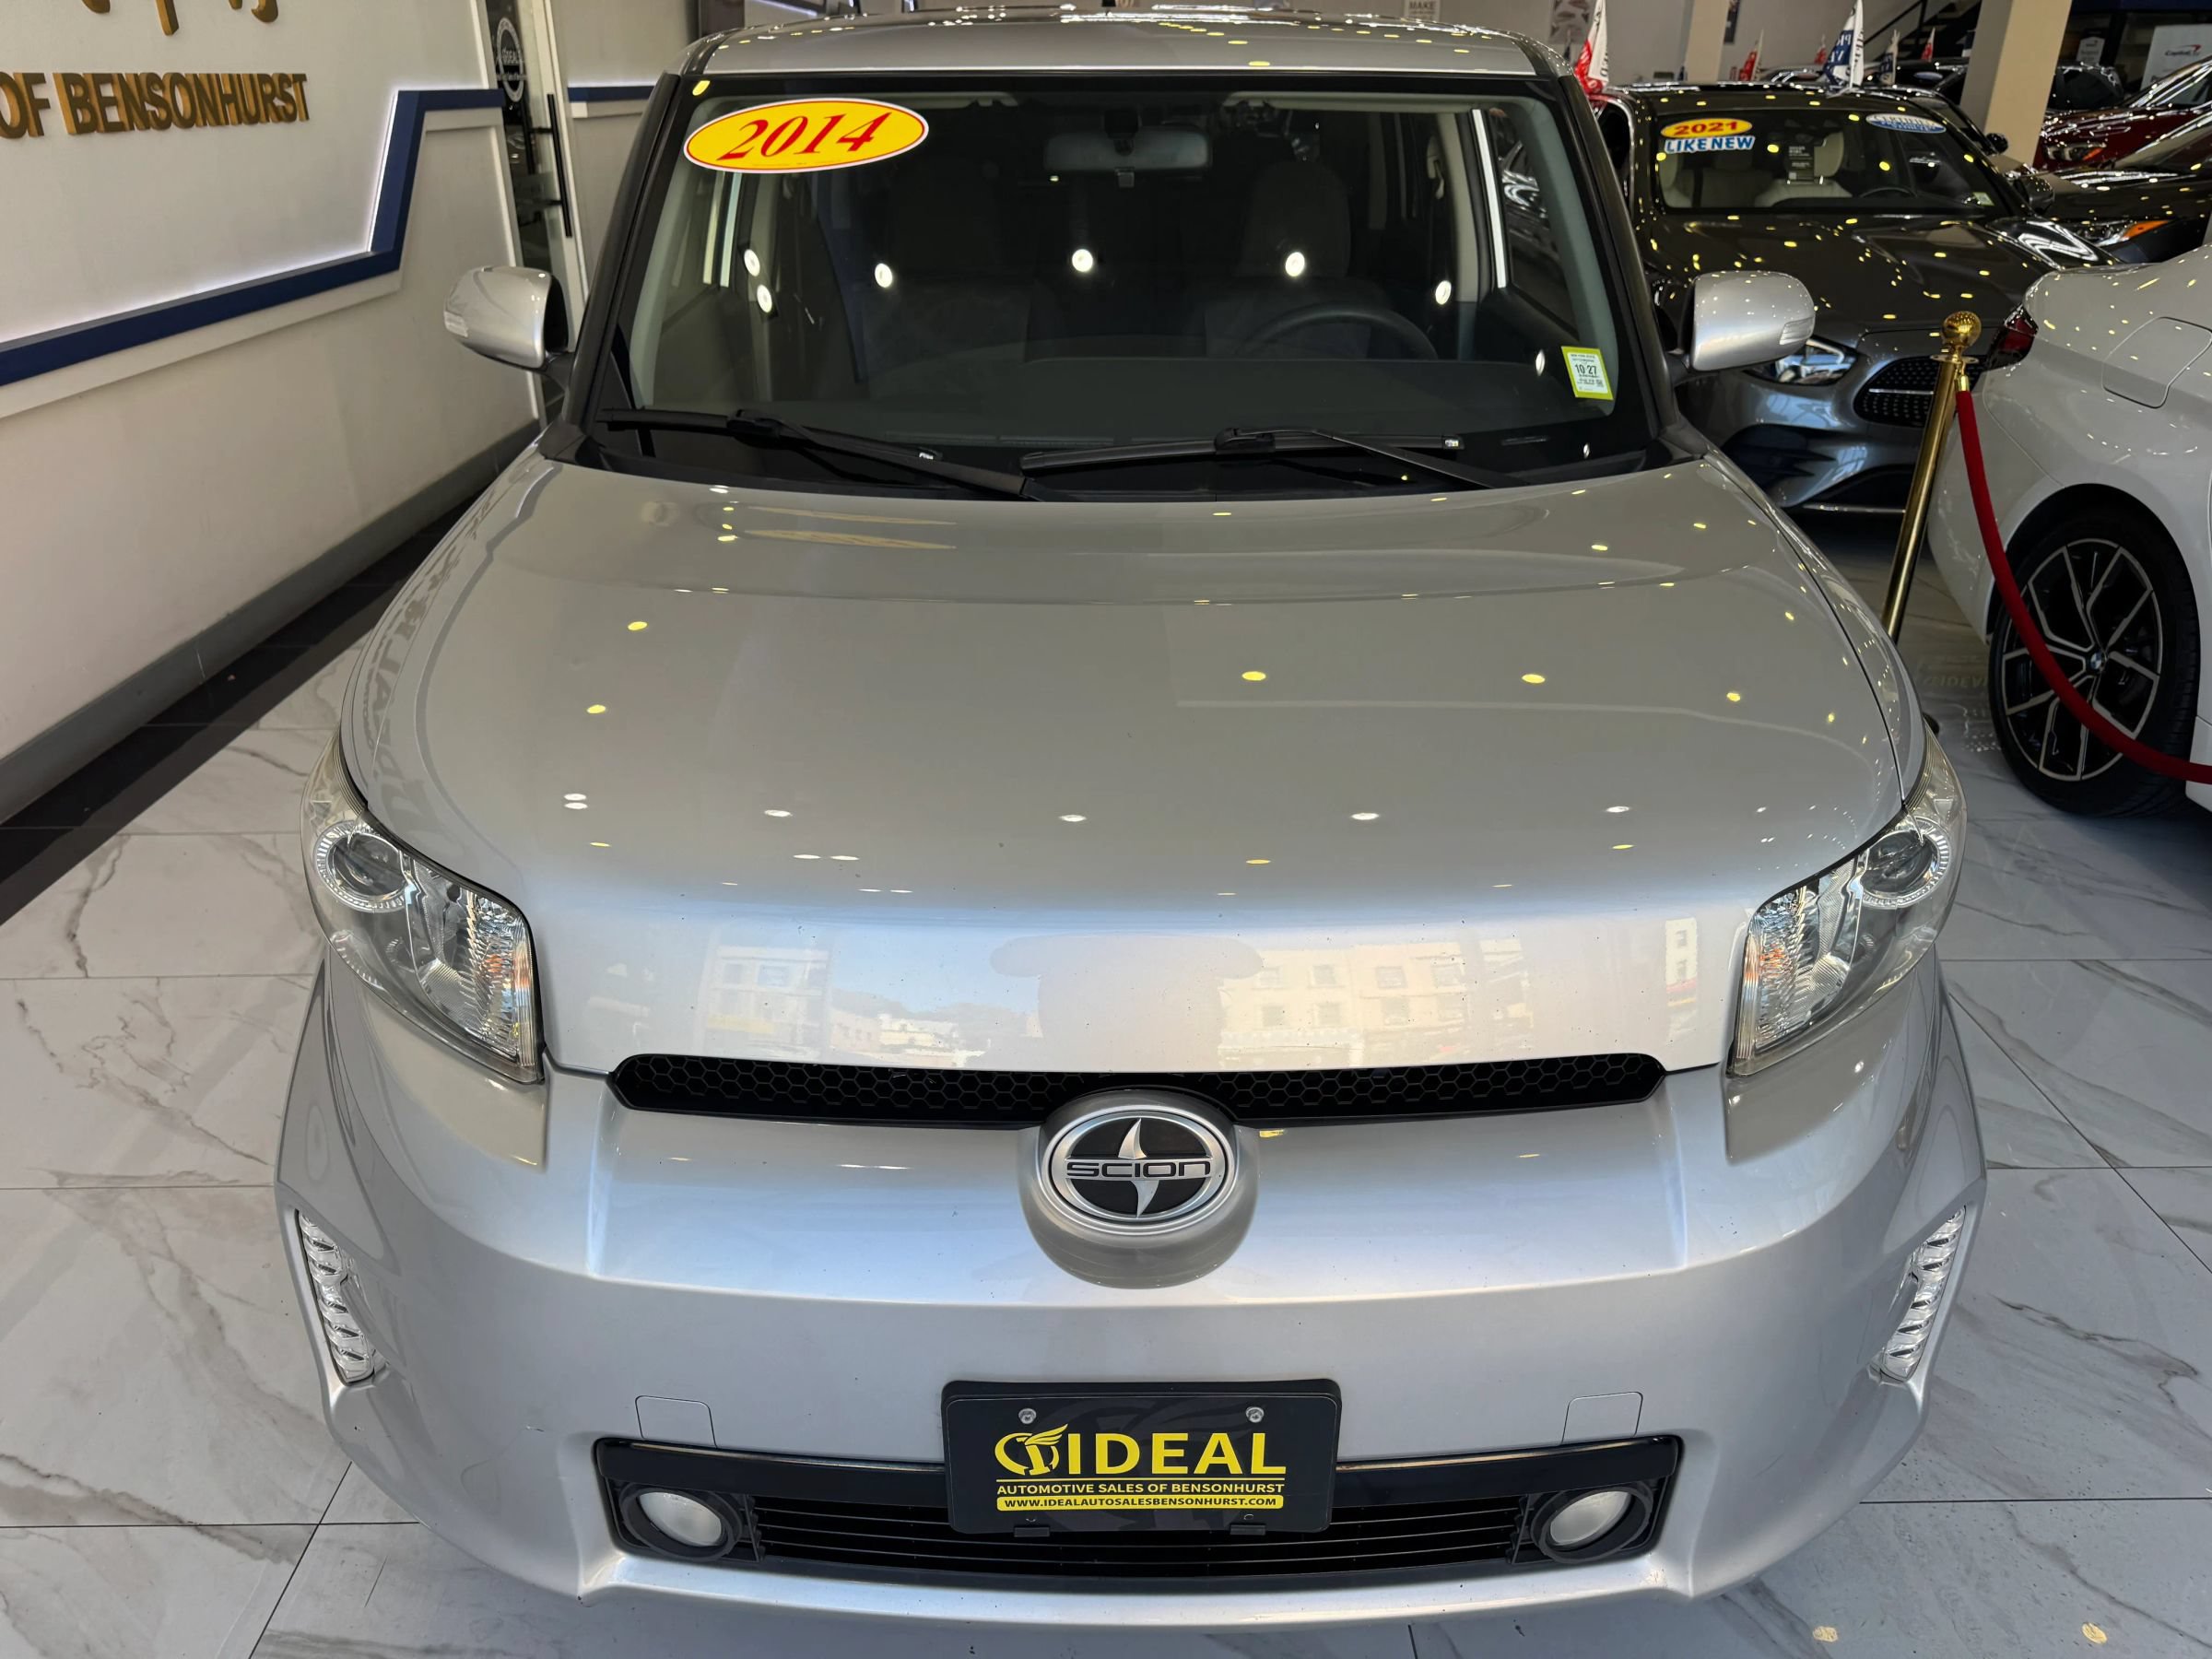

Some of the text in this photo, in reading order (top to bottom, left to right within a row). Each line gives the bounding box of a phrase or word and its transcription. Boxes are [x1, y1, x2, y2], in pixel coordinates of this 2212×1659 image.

[0, 72, 310, 138] OF BENSONHURST
[715, 112, 893, 161] 2014
[1673, 122, 1738, 136] 2021
[1665, 136, 1754, 153] LIKE NEW
[1575, 364, 1597, 376] 10 27
[1068, 1432, 1287, 1475] IDEAL
[996, 1482, 1285, 1495] AUTOMOTIVE SALES OF BENSONHURST
[1004, 1497, 1277, 1508] WWW.IDEALAUTOSALESBENSONHURST.COM
